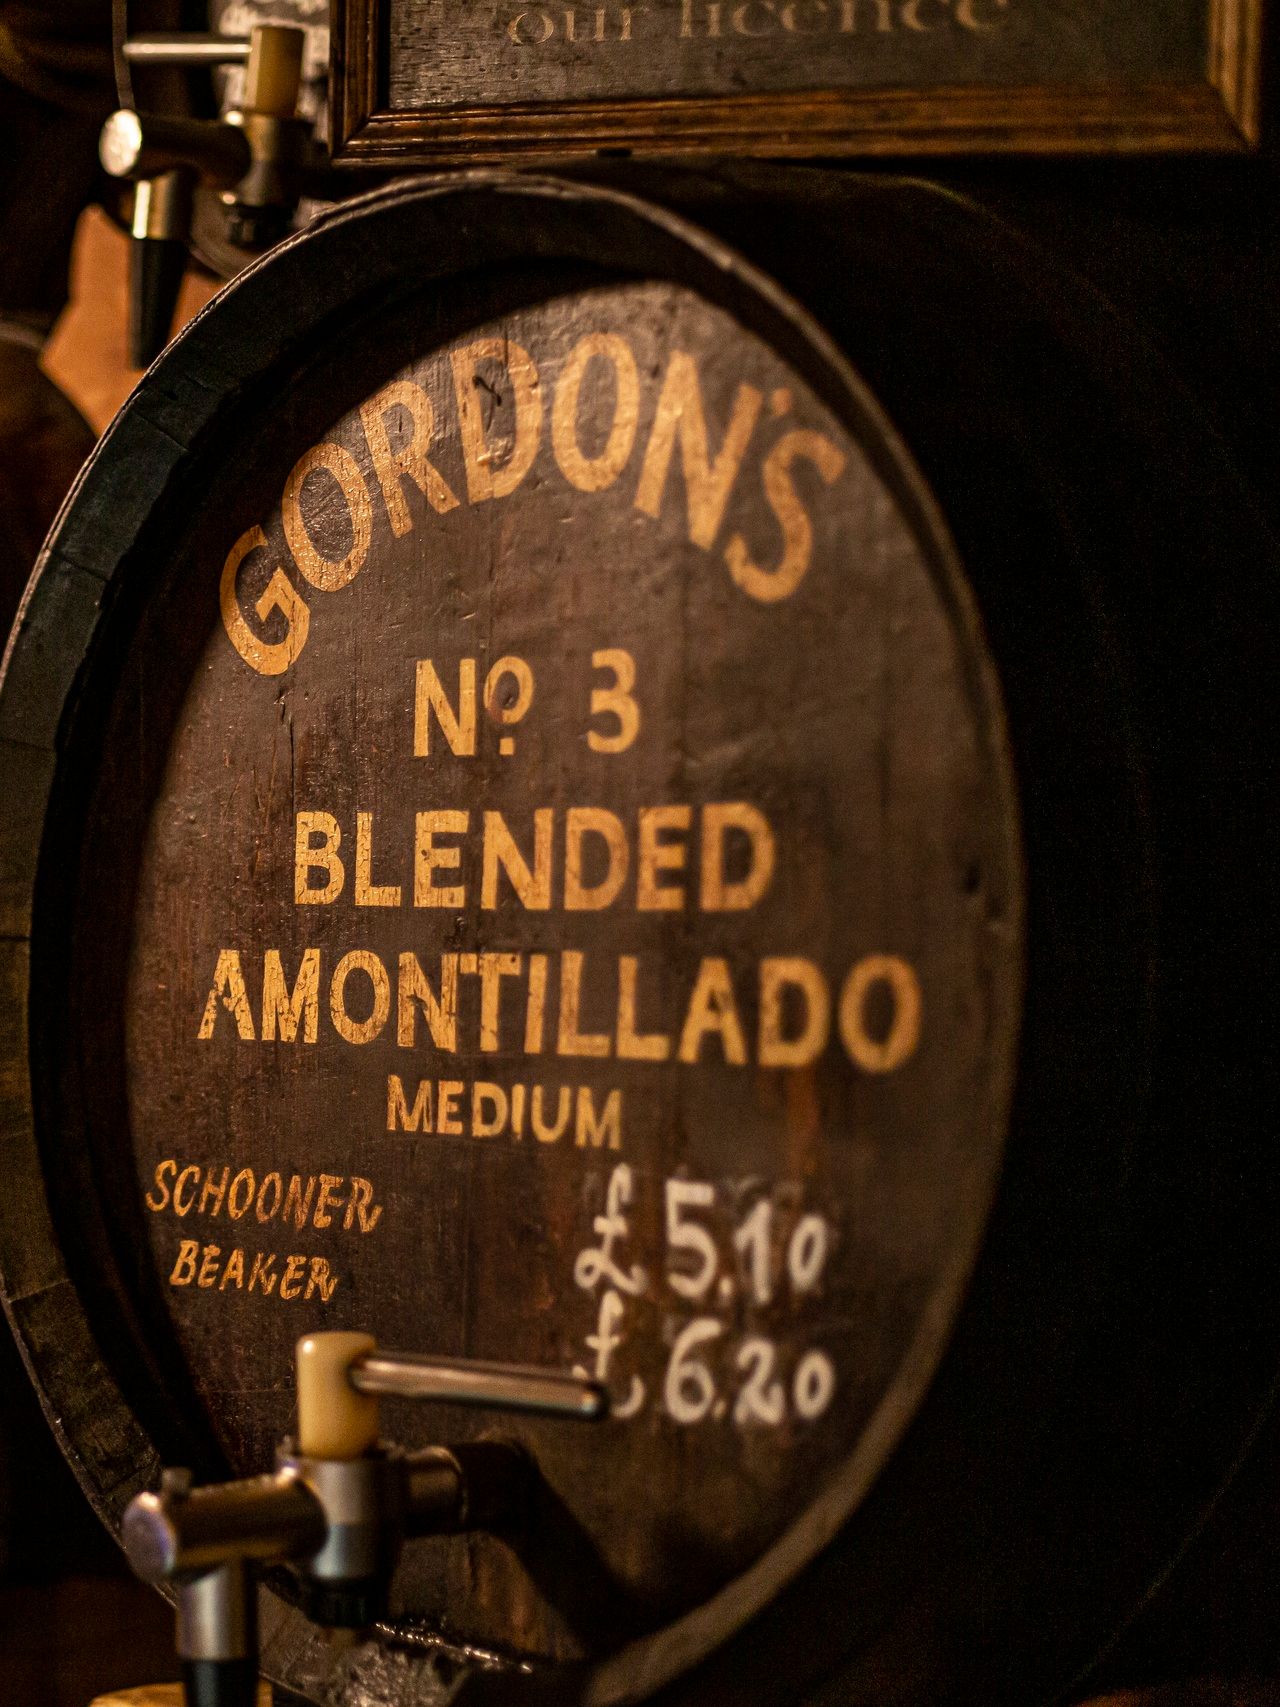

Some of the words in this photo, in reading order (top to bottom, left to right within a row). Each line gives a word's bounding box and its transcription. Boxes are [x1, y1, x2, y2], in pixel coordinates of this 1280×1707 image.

[507, 6, 646, 45] our
[587, 648, 641, 754] 3
[293, 801, 777, 912] BLENDED
[196, 948, 918, 1074] AMONTILLADO
[386, 1074, 624, 1151] MEDIUM
[145, 1159, 383, 1233] SCHOONER
[169, 1239, 338, 1301] BEAKER
